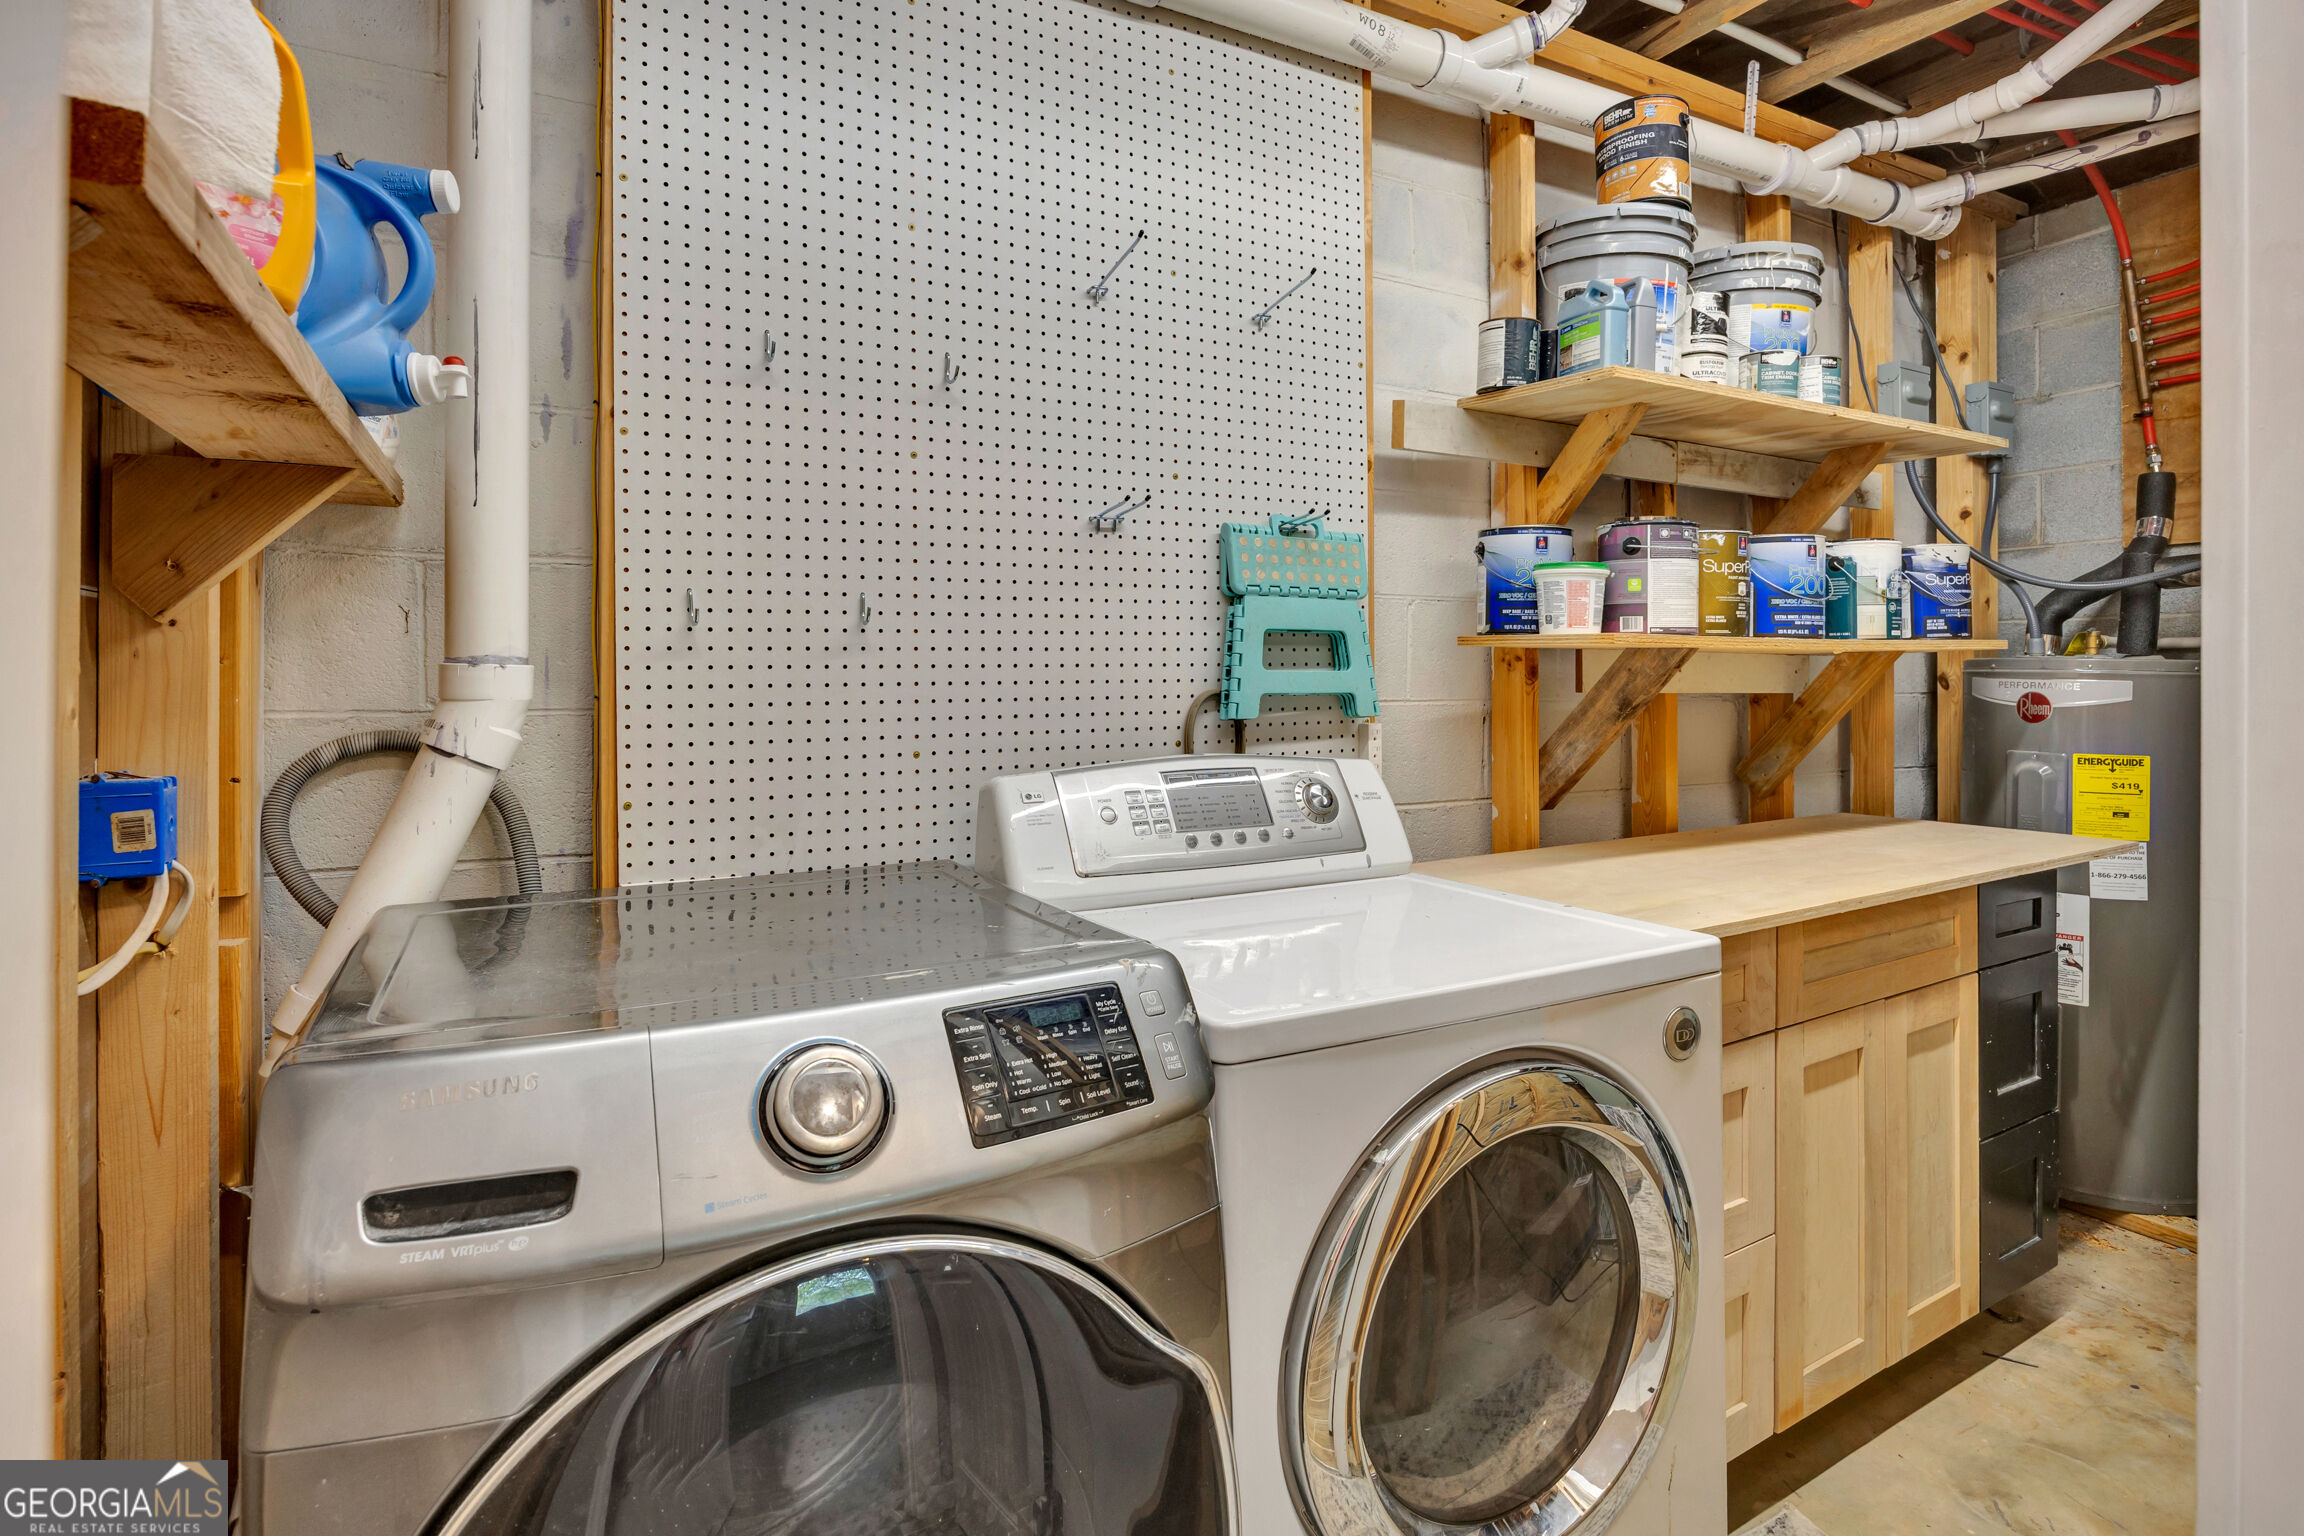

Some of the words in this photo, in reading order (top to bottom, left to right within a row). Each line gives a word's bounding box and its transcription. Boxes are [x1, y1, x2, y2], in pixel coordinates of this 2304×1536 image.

[1604, 109, 1622, 125] BEHR
[1605, 114, 1634, 129] PREMIUM
[1598, 148, 1616, 163] WOOD
[1618, 138, 1648, 151] FINISH
[1528, 339, 1538, 371] BEHR
[1998, 680, 2082, 692] PERFORMANCE
[2020, 692, 2050, 720] Rheem
[2076, 757, 2145, 773] ENERGYGUIDE
[2091, 871, 2147, 880] 1-866-279-4566
[953, 1027, 969, 1035] Extra
[969, 1023, 985, 1031] Rinse
[1104, 1027, 1118, 1036] Delay
[1118, 1024, 1128, 1032] End
[963, 1055, 979, 1063] Extra
[978, 1052, 992, 1060] Spin
[1083, 1053, 1098, 1061] Heavy
[1048, 1060, 1068, 1068] Medium
[1016, 1077, 1032, 1085] Warm
[1088, 1072, 1101, 1080] Light
[971, 1083, 985, 1092] Spin
[985, 1080, 999, 1089] Only
[1124, 1079, 1140, 1089] Sound
[399, 1071, 540, 1111] SAMSUNG
[1086, 1090, 1098, 1098] Soil
[1097, 1087, 1111, 1096] Level
[1058, 1097, 1072, 1106] Spin
[1021, 1105, 1039, 1115] Temp.
[984, 1112, 1002, 1122] Steam
[716, 1198, 742, 1210] Steam
[743, 1191, 769, 1204] Cycles
[399, 1248, 445, 1265] STEAM
